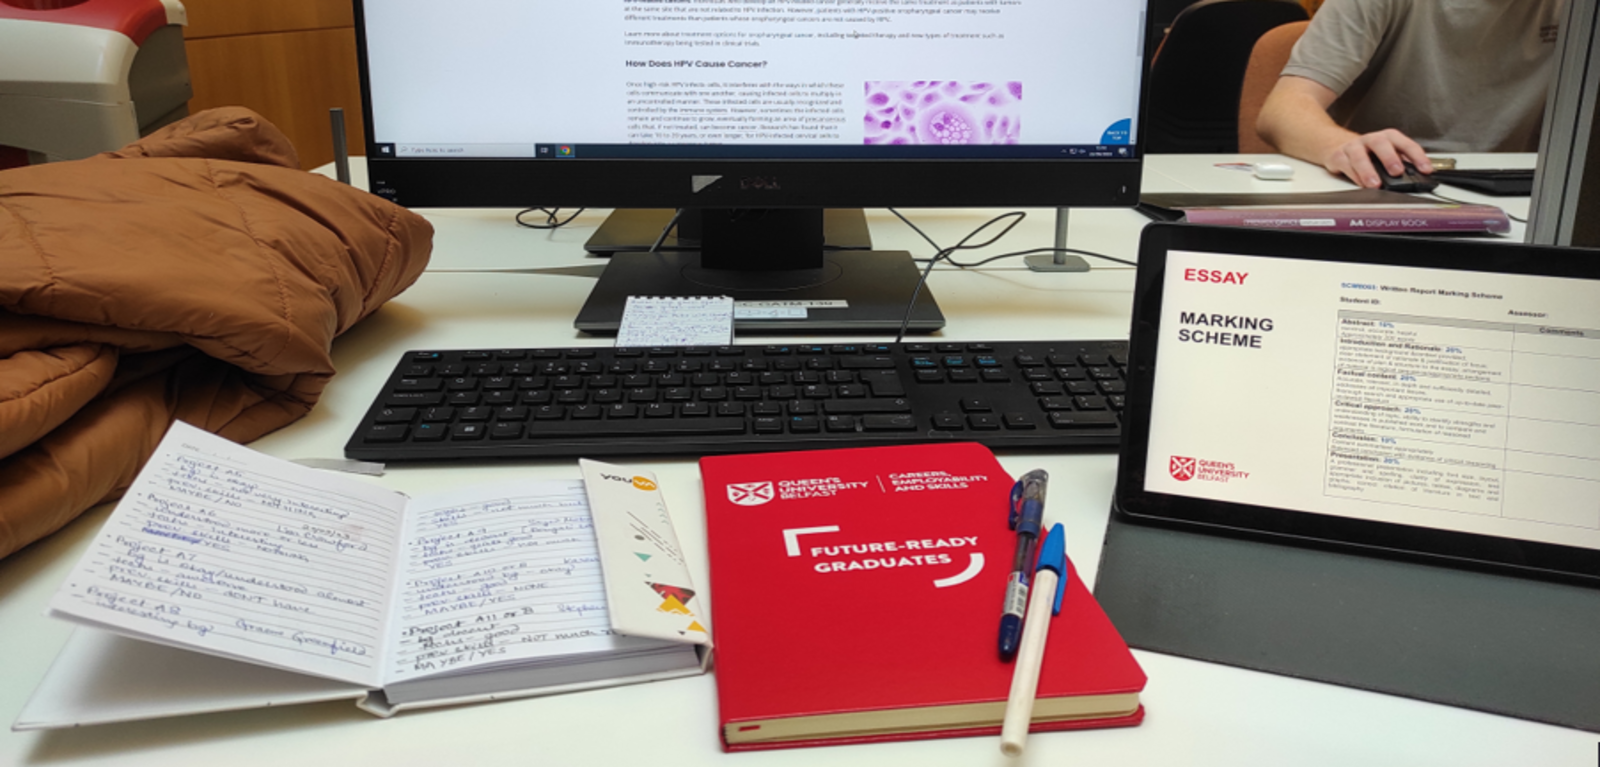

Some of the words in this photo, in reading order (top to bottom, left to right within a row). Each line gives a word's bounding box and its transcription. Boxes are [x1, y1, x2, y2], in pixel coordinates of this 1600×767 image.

[673, 60, 693, 68] HPV
[695, 60, 726, 68] Cause
[727, 60, 768, 68] Cancer?
[1350, 219, 1365, 227] A4
[1365, 219, 1400, 227] DISPLAY
[1401, 219, 1428, 227] BOOK
[1184, 268, 1249, 285] ESSAY
[1380, 285, 1408, 293] Written
[1410, 287, 1436, 295] Report
[1438, 289, 1469, 298] Marking
[1471, 292, 1503, 300] Scheme
[1180, 311, 1274, 332] MARKING
[1539, 326, 1585, 336] Comments
[1178, 328, 1262, 349] SCHEME
[1198, 458, 1236, 470] QUEEN'S
[889, 470, 952, 479] CAREERS,
[1197, 466, 1250, 479] UNIVERSITY
[1197, 473, 1229, 483] BELFAST
[778, 476, 841, 488] QUEEN'S
[891, 475, 988, 485] EMPLOYABILITY
[778, 481, 869, 493] UNIVERSITY
[894, 484, 925, 492] AND
[926, 482, 969, 490] SKILLS
[780, 490, 837, 500] BELFAST
[116, 535, 169, 553] Project
[810, 536, 979, 557] FUTURE-READY
[814, 553, 952, 573] GRADUATES
[86, 585, 145, 607] Project
